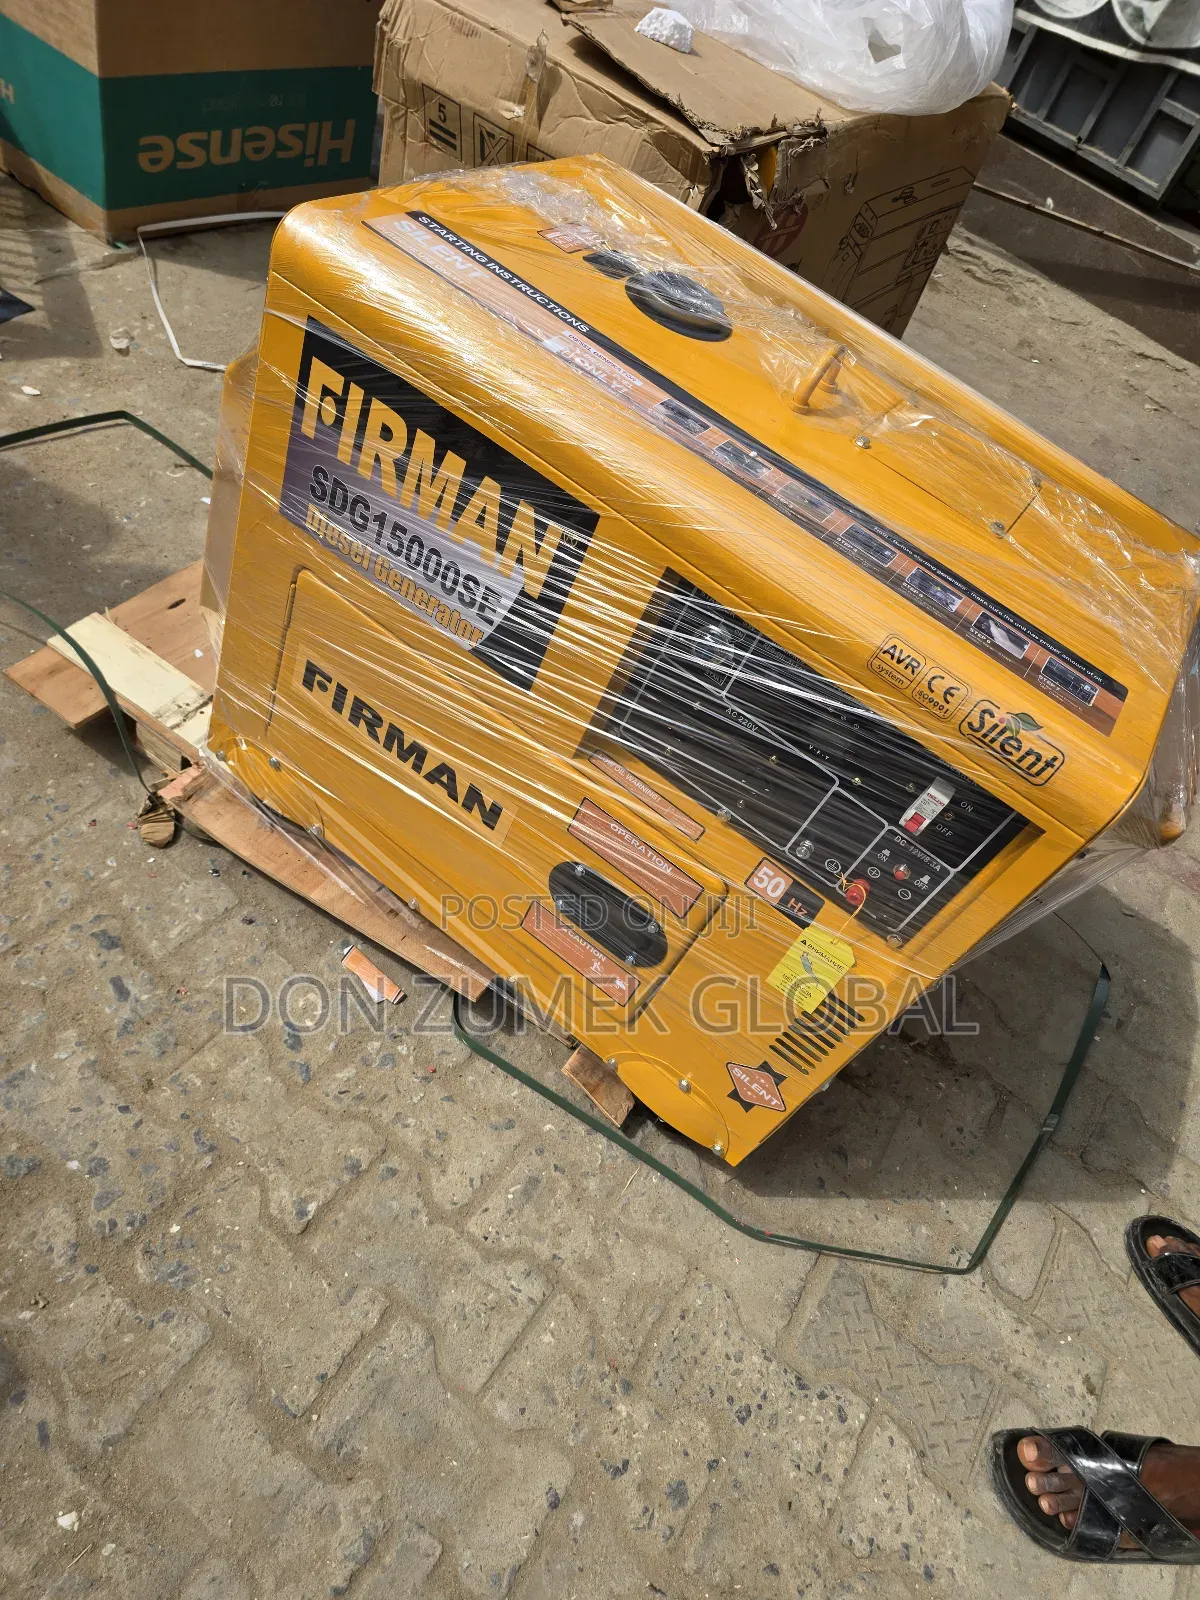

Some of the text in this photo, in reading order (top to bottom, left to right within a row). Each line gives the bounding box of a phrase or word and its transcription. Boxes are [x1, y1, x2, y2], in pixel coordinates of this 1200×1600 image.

[138, 119, 356, 173] Hisense
[393, 220, 491, 280] SILENT
[418, 216, 489, 263] STARTING
[486, 263, 590, 333] INSTRUCTIONS
[301, 355, 565, 599] FIRMAN
[309, 464, 503, 627] SDG15000SE
[373, 555, 485, 647] Generator
[876, 663, 905, 686] system
[881, 644, 921, 677] AVR
[927, 674, 961, 705] CE
[725, 707, 759, 732] AC 220V
[301, 659, 503, 831] FIRMAN
[967, 708, 1059, 779] Silent
[614, 765, 625, 777] OIL
[626, 773, 661, 803] WARNING!
[960, 801, 974, 813] ON
[610, 822, 673, 874] OPERATION
[894, 835, 907, 847] DC
[935, 823, 954, 837] OFF
[877, 851, 889, 863] ON
[753, 866, 808, 917] 50 Hz
[913, 879, 929, 890] OFF
[566, 929, 607, 962] CAUTION
[732, 1067, 781, 1106] SILENT
